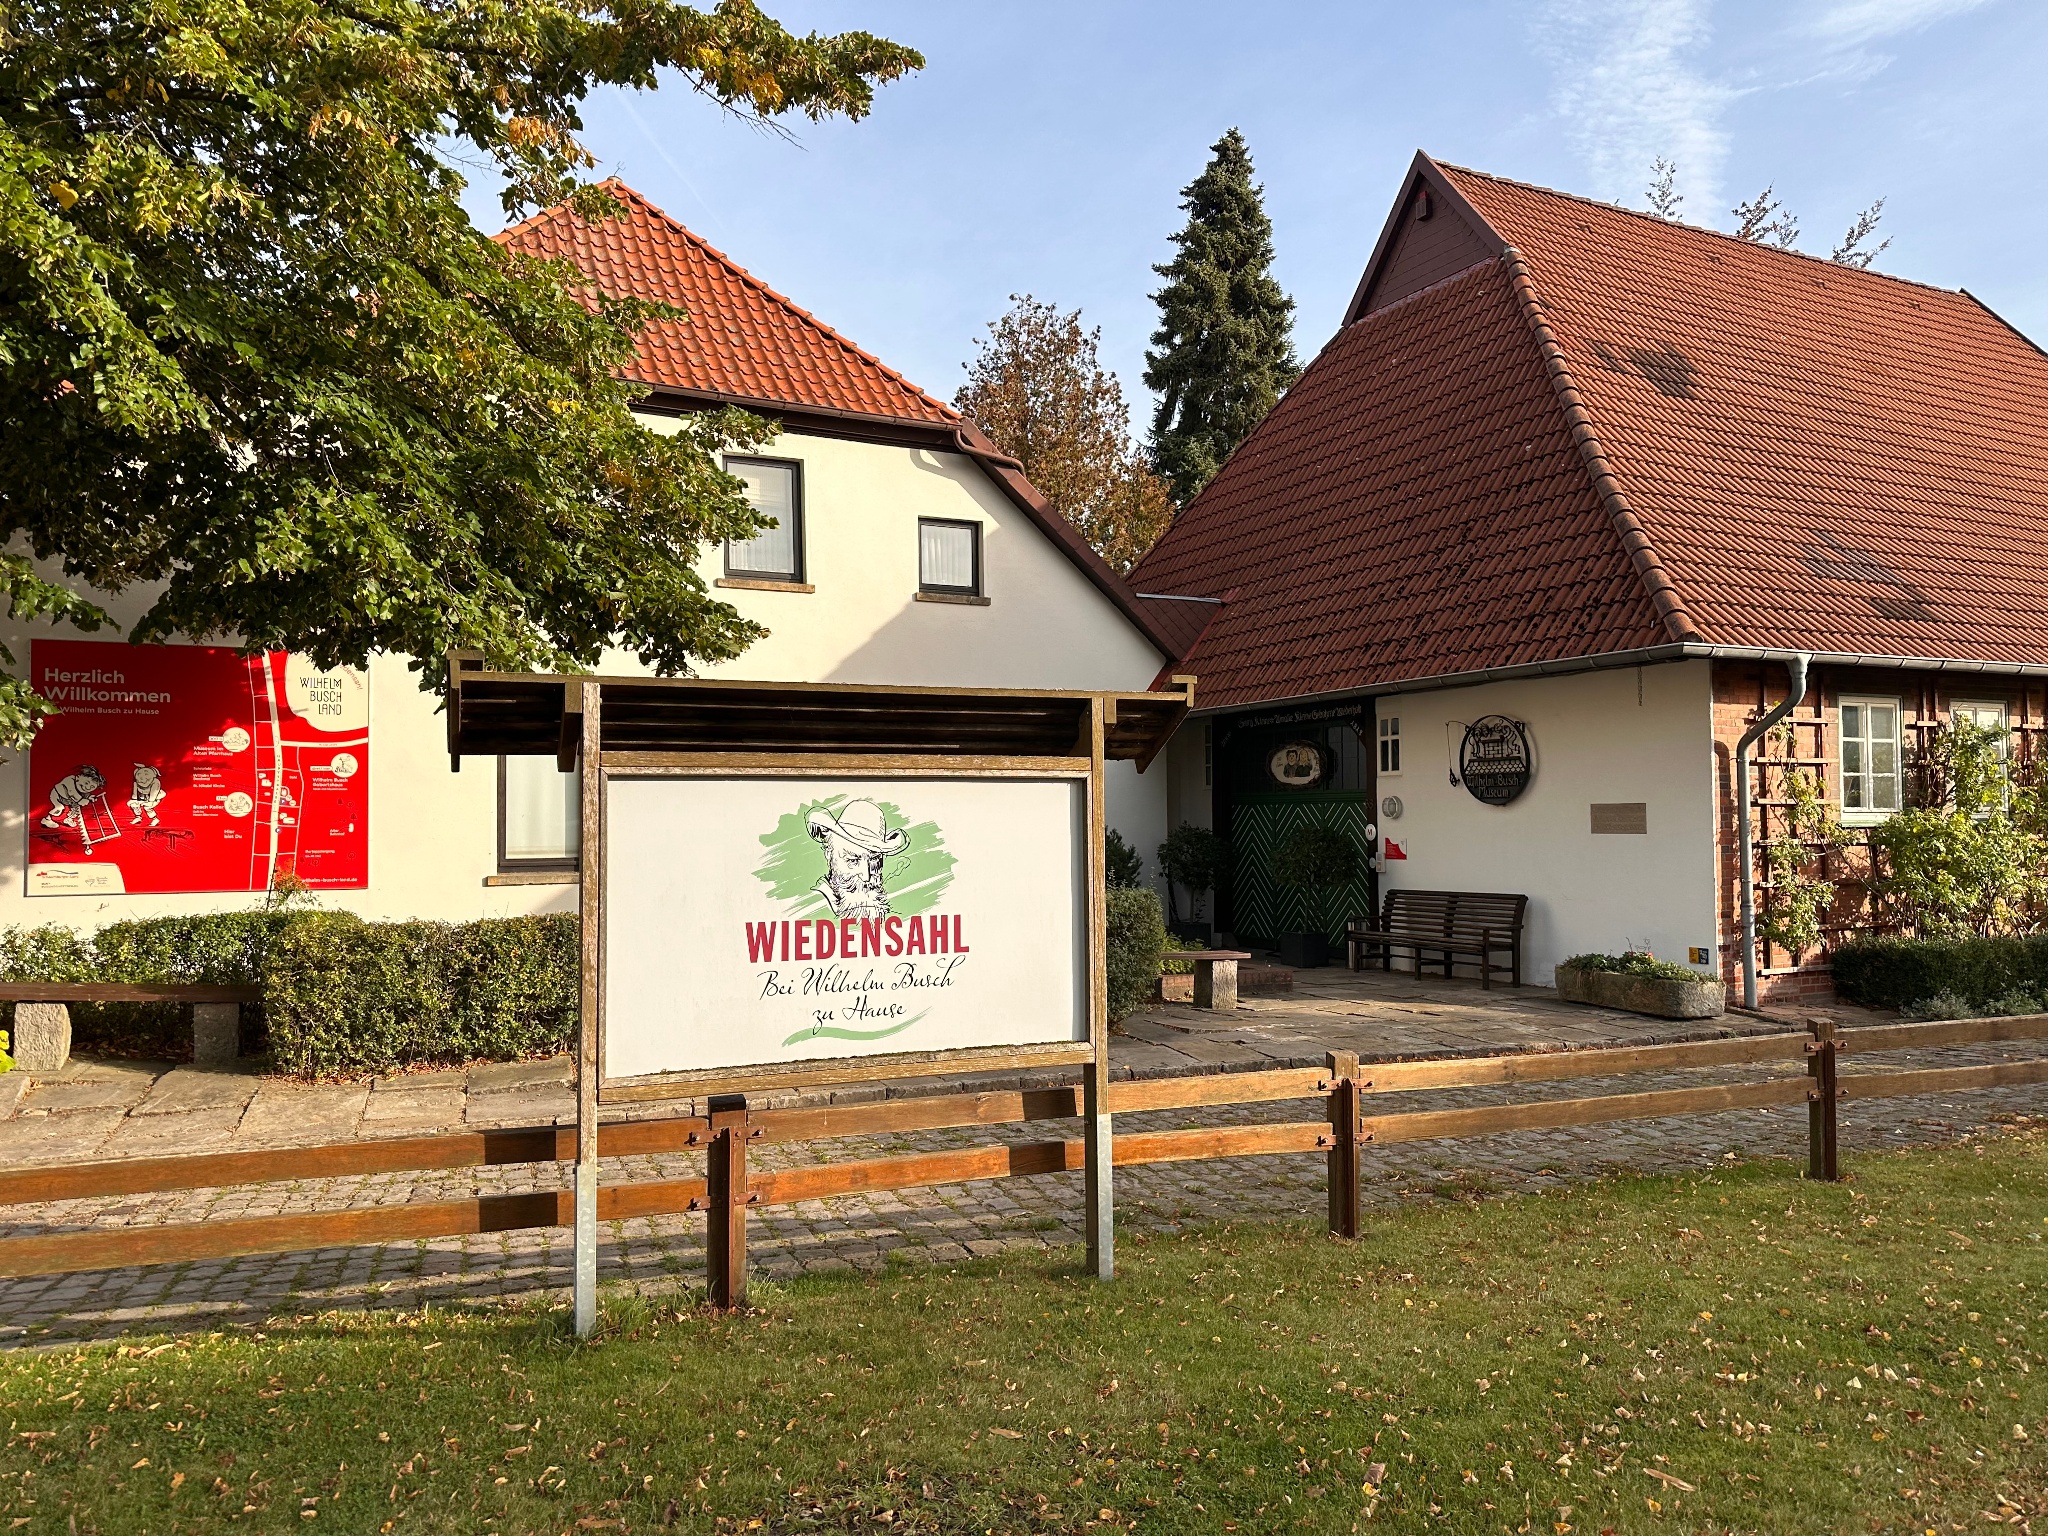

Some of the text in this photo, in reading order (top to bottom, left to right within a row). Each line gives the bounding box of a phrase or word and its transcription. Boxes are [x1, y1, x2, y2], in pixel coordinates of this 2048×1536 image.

[44, 667, 125, 684] Herzlich
[299, 676, 342, 690] WILHELM
[43, 685, 171, 703] Willkommen
[310, 690, 342, 703] BUSCH
[60, 706, 95, 714] Wilhelm
[135, 707, 160, 715] Hause
[318, 703, 342, 716] LAND
[1478, 786, 1509, 798] Museum
[745, 912, 970, 963] WIEDENSAHL
[757, 955, 967, 1001] Bei Wilhelm Busch
[812, 994, 907, 1036] zu Hause
